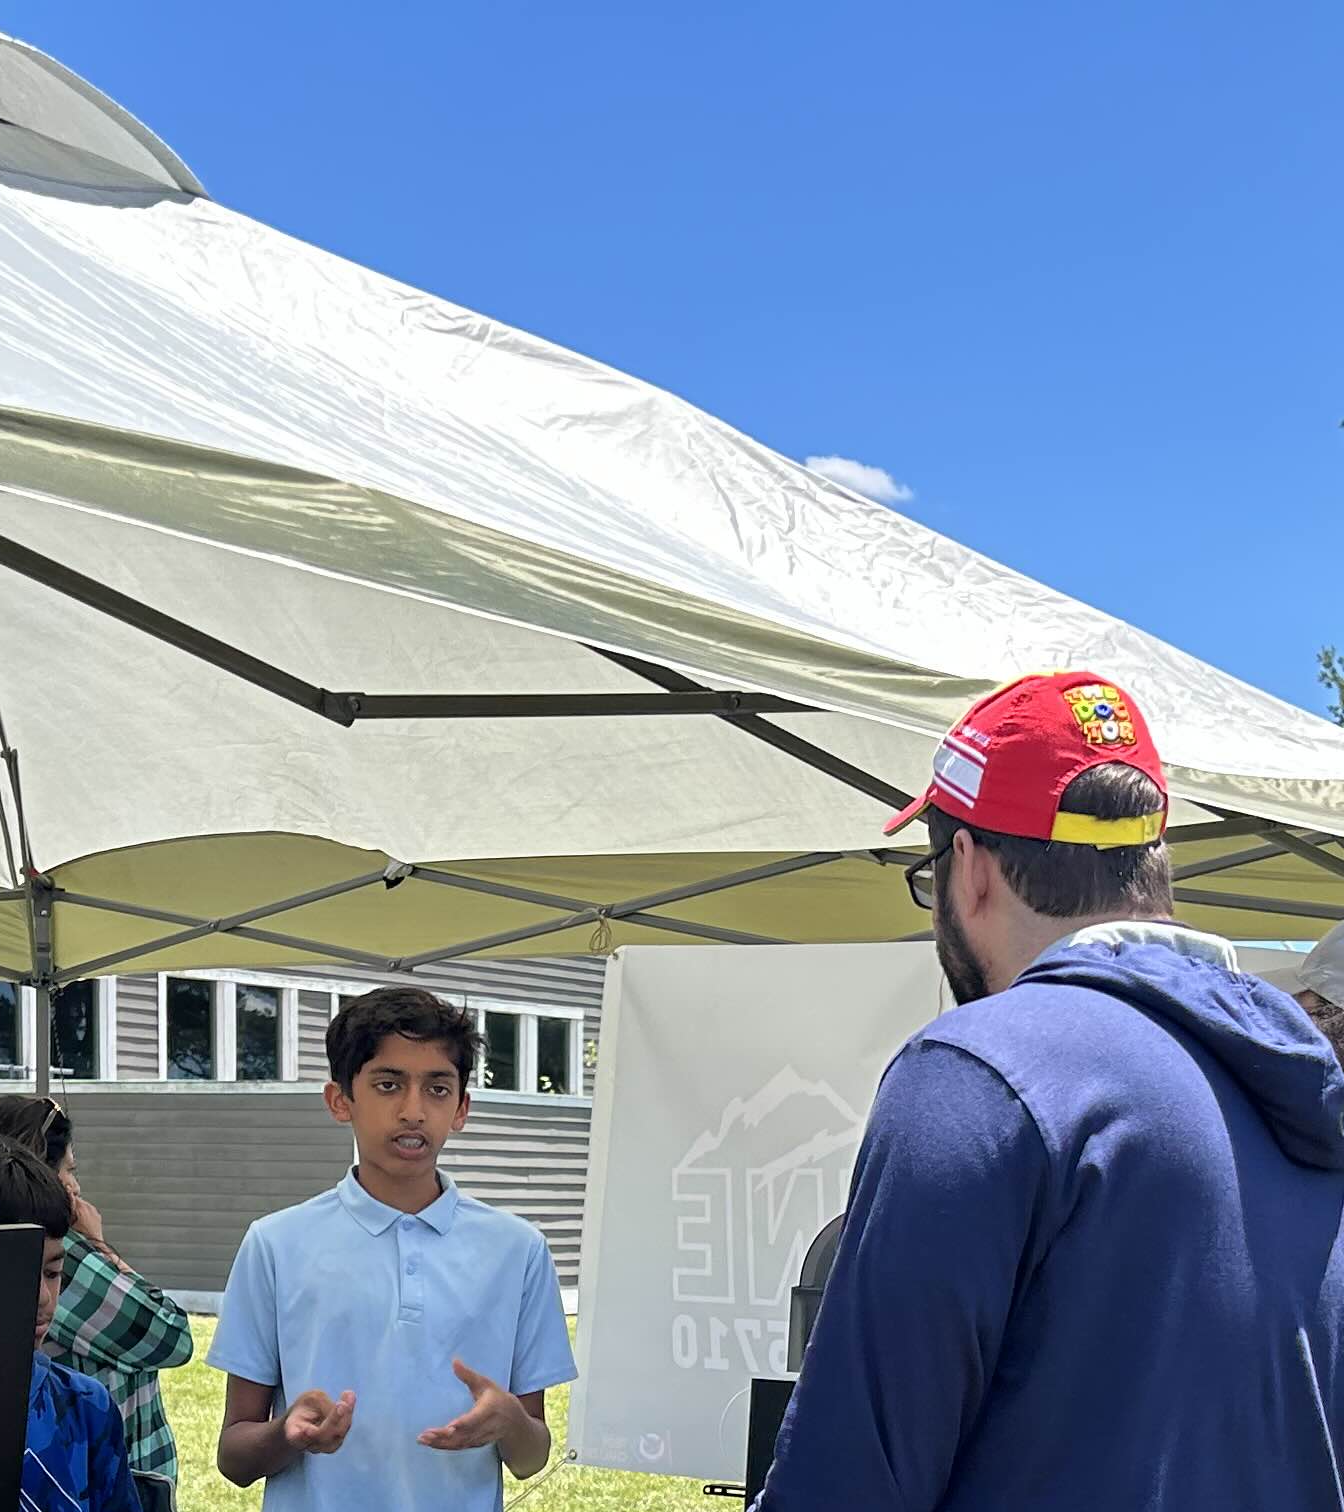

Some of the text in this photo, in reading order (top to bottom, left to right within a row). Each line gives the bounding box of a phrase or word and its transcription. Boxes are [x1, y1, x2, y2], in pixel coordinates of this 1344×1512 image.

[1063, 685, 1120, 703] THE
[1072, 701, 1130, 722] DOC
[1084, 720, 1137, 745] TOR
